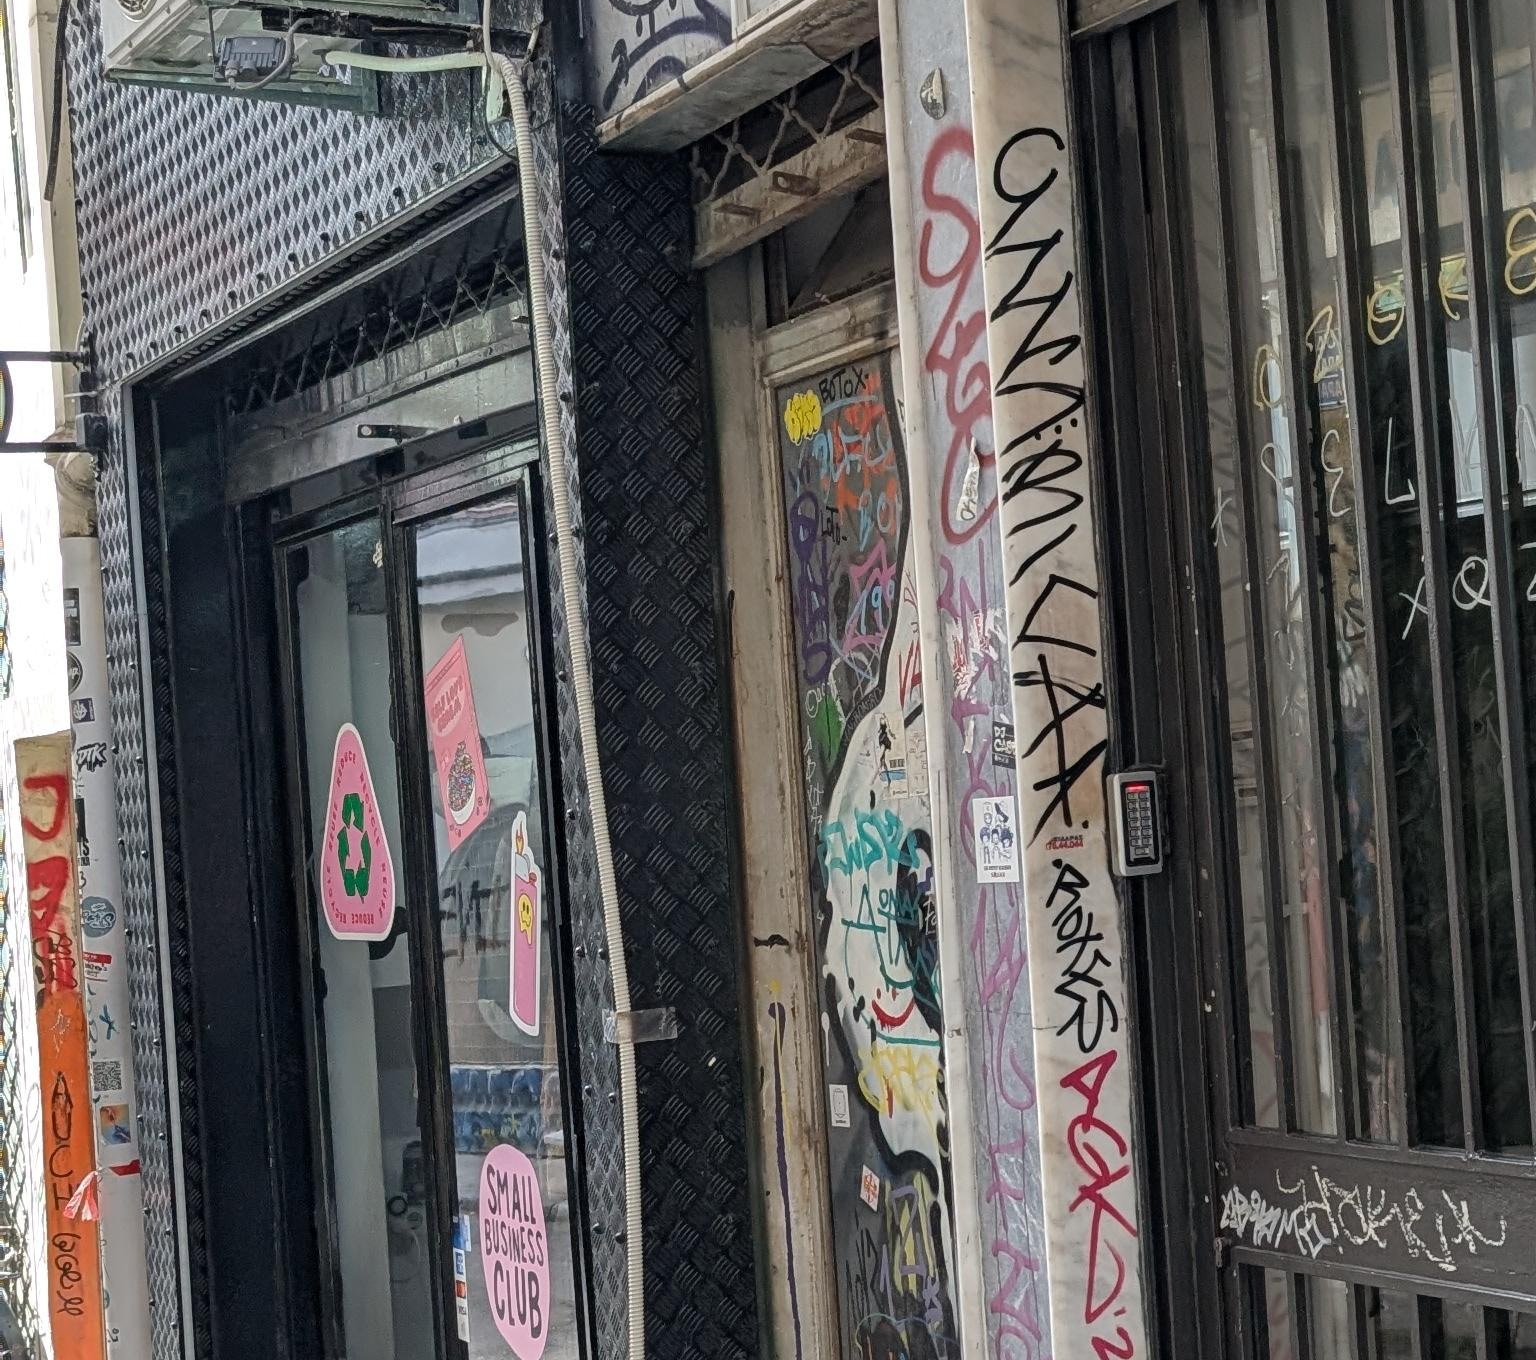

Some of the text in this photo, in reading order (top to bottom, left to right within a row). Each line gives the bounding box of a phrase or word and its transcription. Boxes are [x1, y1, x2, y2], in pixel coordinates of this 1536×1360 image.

[486, 1163, 537, 1225] SMALL
[483, 1218, 545, 1267] BUSINESS
[493, 1259, 543, 1339] CLUB
